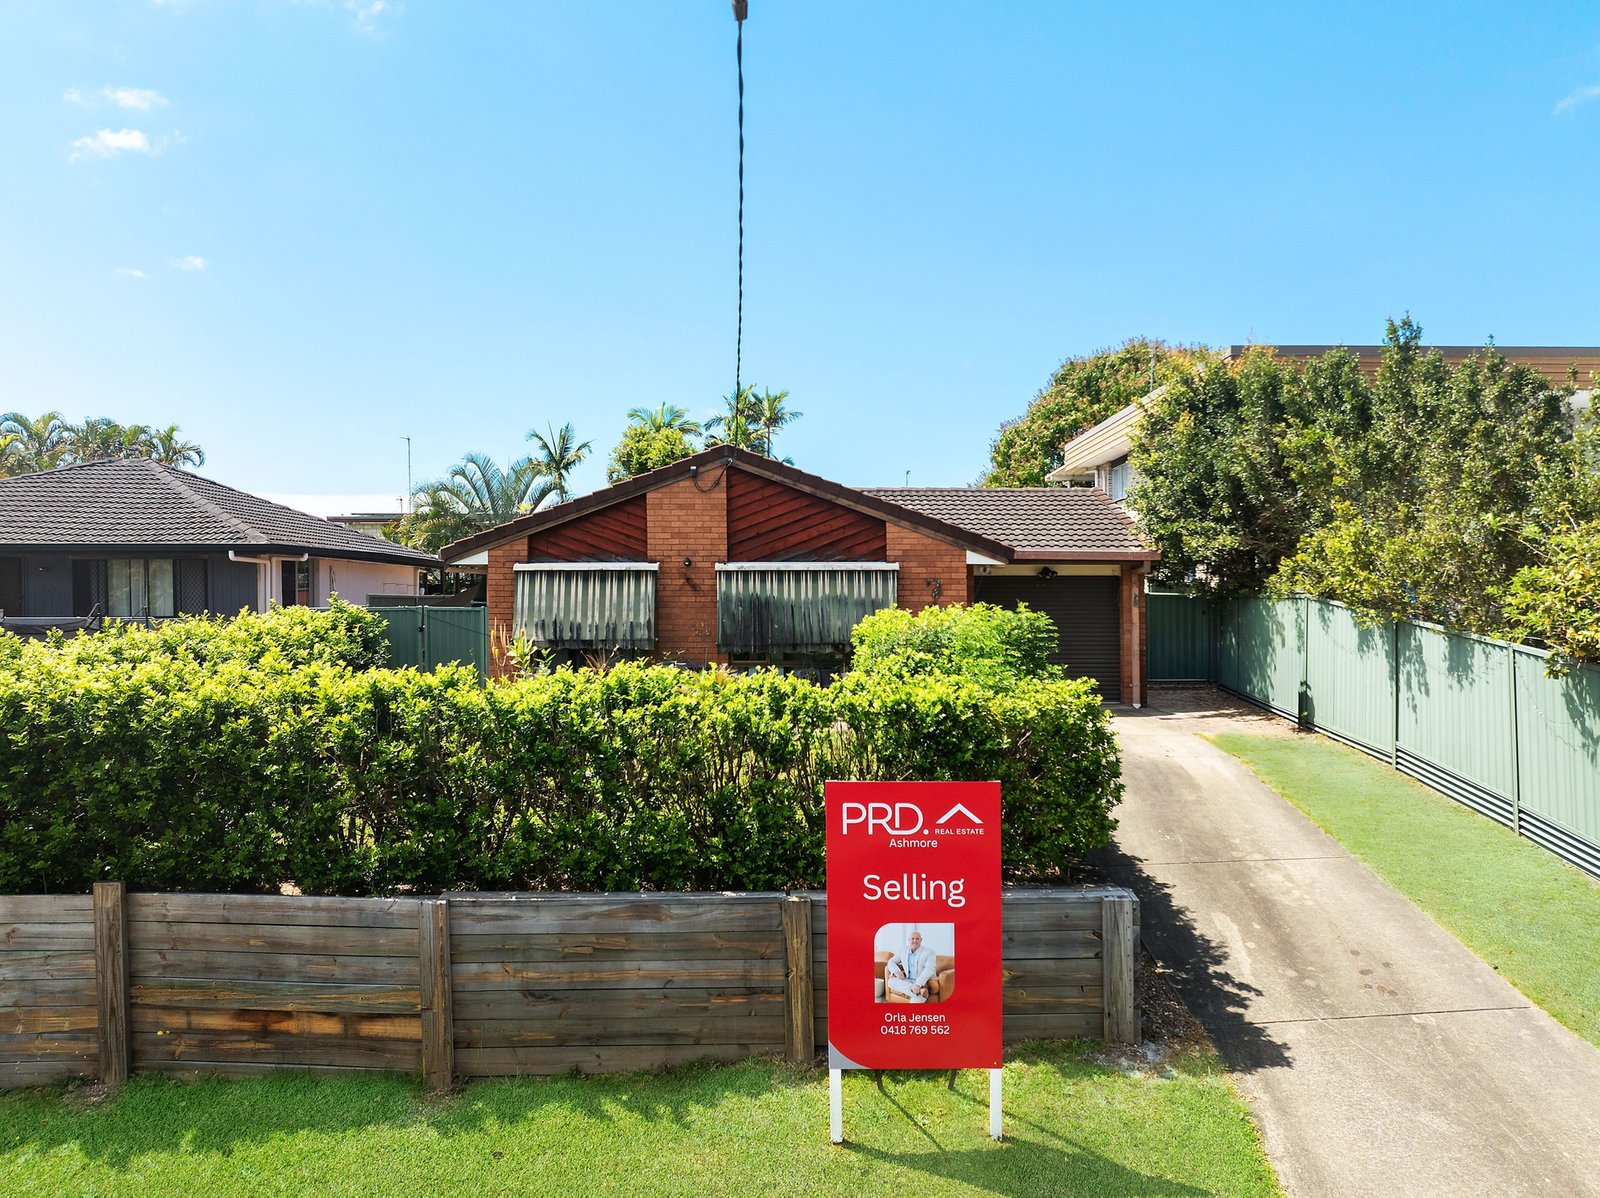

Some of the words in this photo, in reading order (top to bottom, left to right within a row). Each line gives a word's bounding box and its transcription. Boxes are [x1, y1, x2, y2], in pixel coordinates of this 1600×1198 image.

[889, 838, 938, 848] Ashmore
[863, 874, 965, 908] Selling
[884, 1012, 907, 1023] Orla
[908, 1012, 946, 1023] Jensen
[880, 1025, 907, 1035] 0418
[909, 1025, 928, 1035] 769
[930, 1025, 950, 1035] 562
